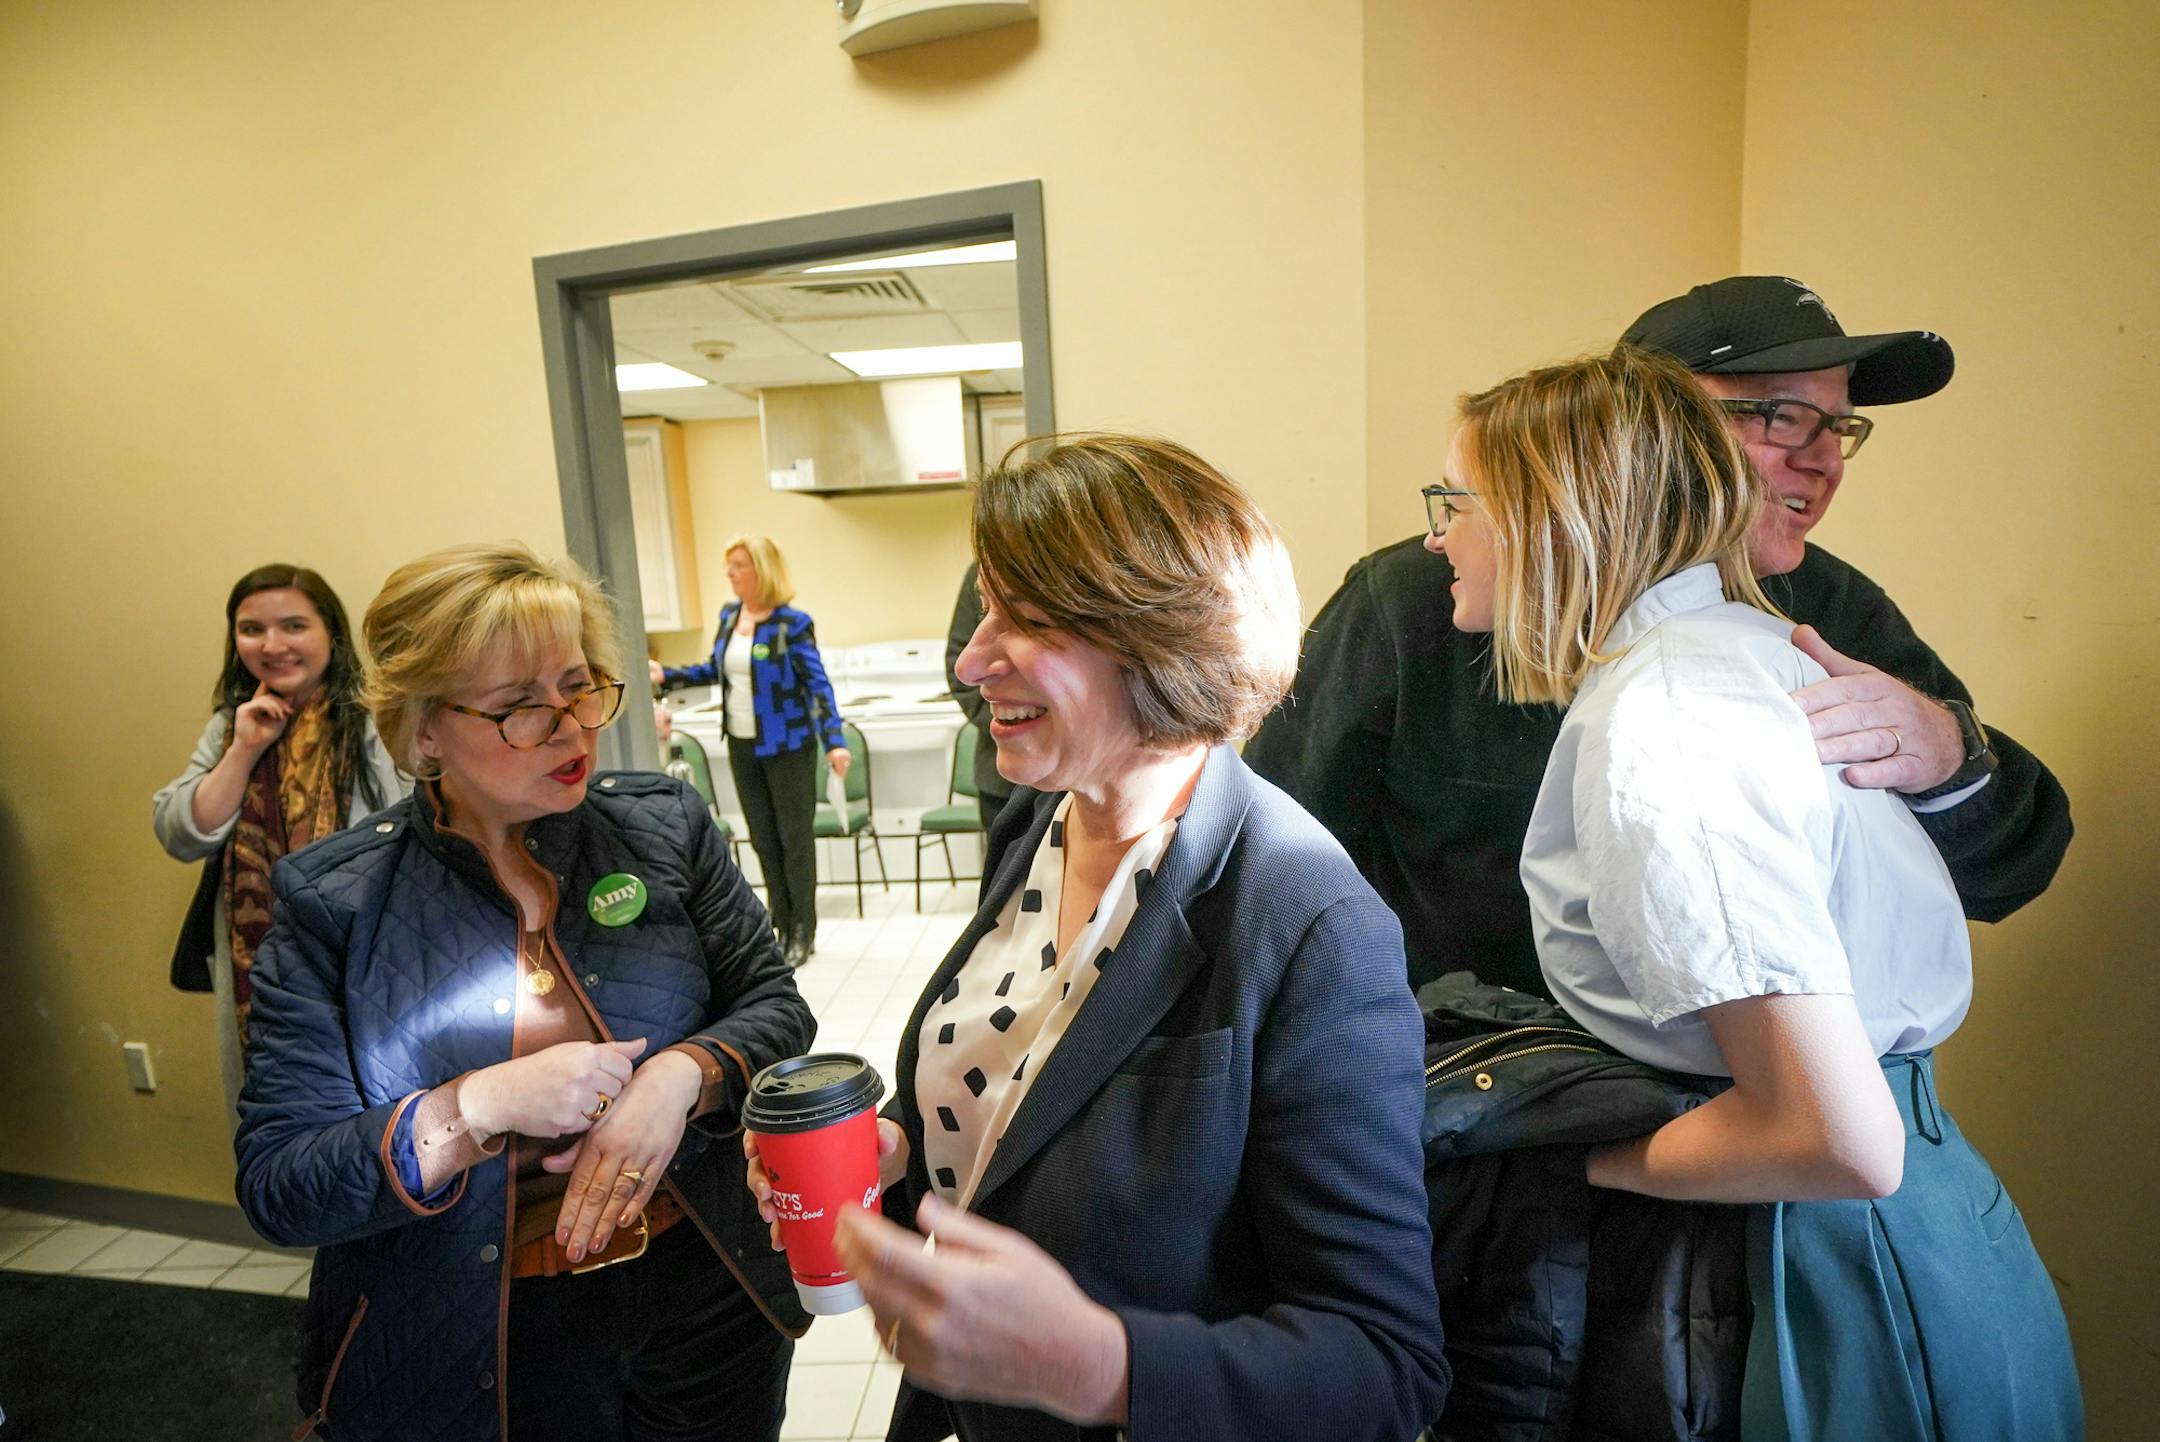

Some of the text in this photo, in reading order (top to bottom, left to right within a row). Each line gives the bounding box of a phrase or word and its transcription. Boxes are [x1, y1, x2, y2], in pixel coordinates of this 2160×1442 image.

[592, 882, 638, 912] Amy
[787, 1211, 800, 1220] For
[801, 1207, 824, 1220] Good
